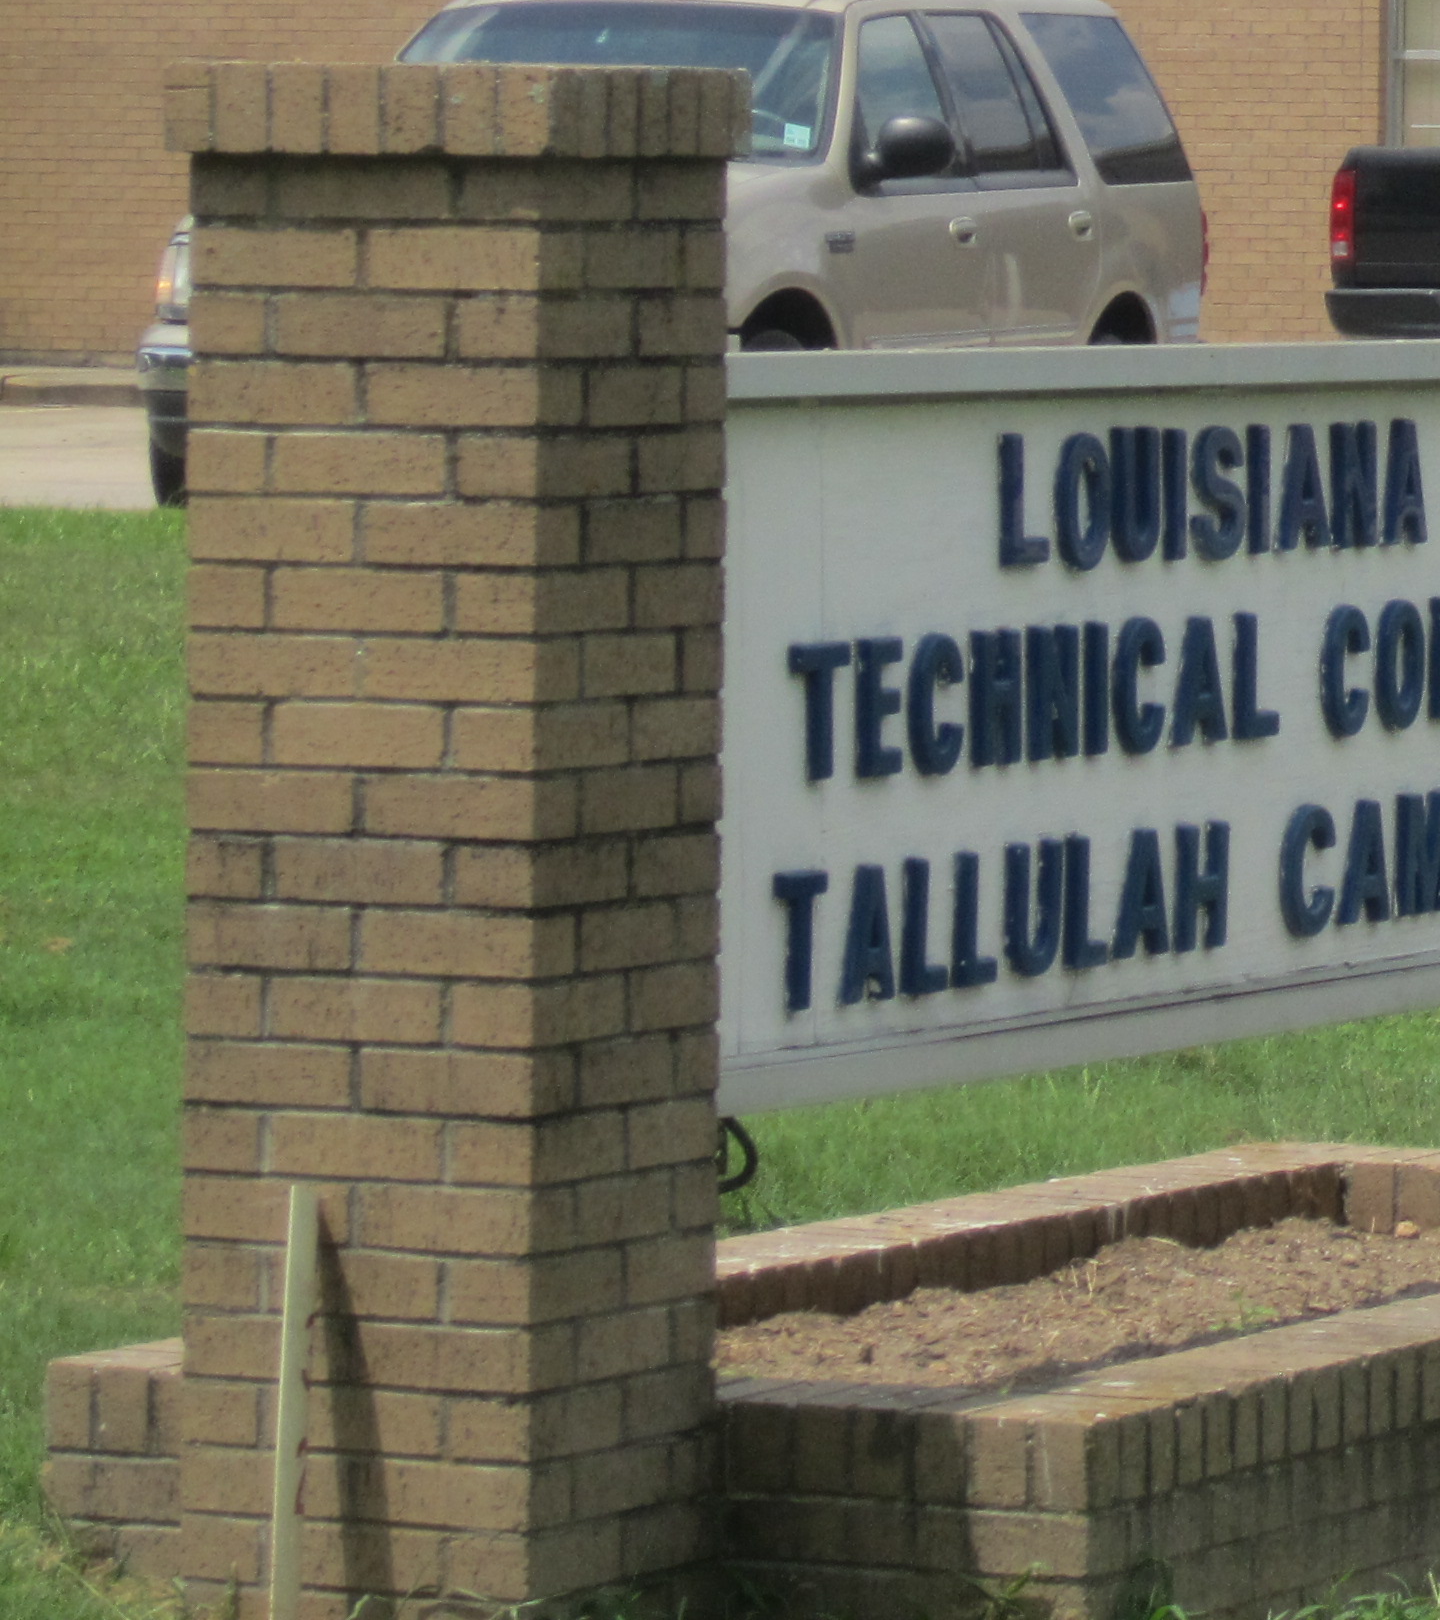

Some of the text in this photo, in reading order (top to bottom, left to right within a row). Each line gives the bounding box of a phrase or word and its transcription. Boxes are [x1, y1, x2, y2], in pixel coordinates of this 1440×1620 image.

[996, 416, 1428, 572] LOUISIANA
[786, 611, 1280, 781] TECHNICAL
[771, 820, 1229, 1012] TALLULAH
